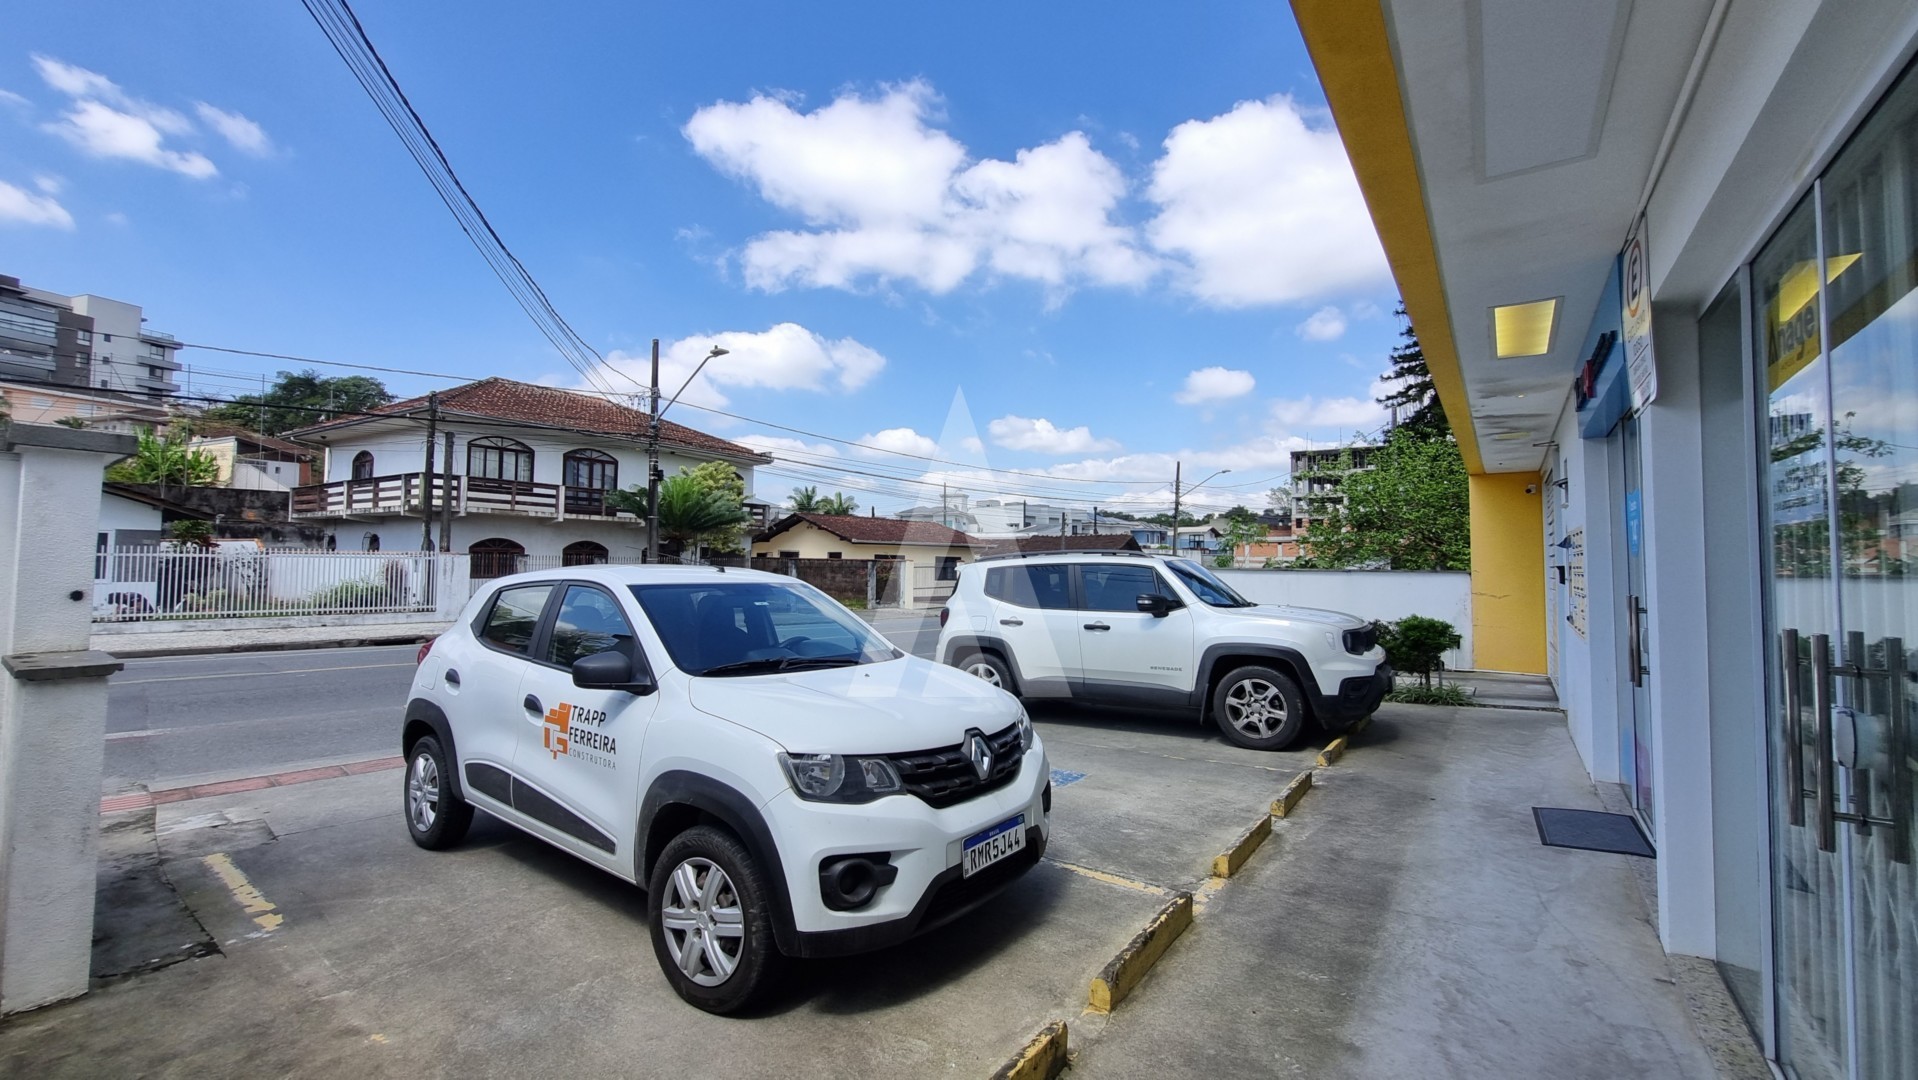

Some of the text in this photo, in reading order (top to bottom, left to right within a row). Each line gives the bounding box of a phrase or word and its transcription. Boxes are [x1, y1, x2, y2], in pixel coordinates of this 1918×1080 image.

[1631, 254, 1638, 301] E
[1768, 305, 1815, 367] Anage
[571, 705, 607, 728] TRAPP
[568, 726, 617, 755] FERREIRA
[568, 747, 617, 771] CONSTRUTORA
[970, 828, 1020, 871] RMR5J44
